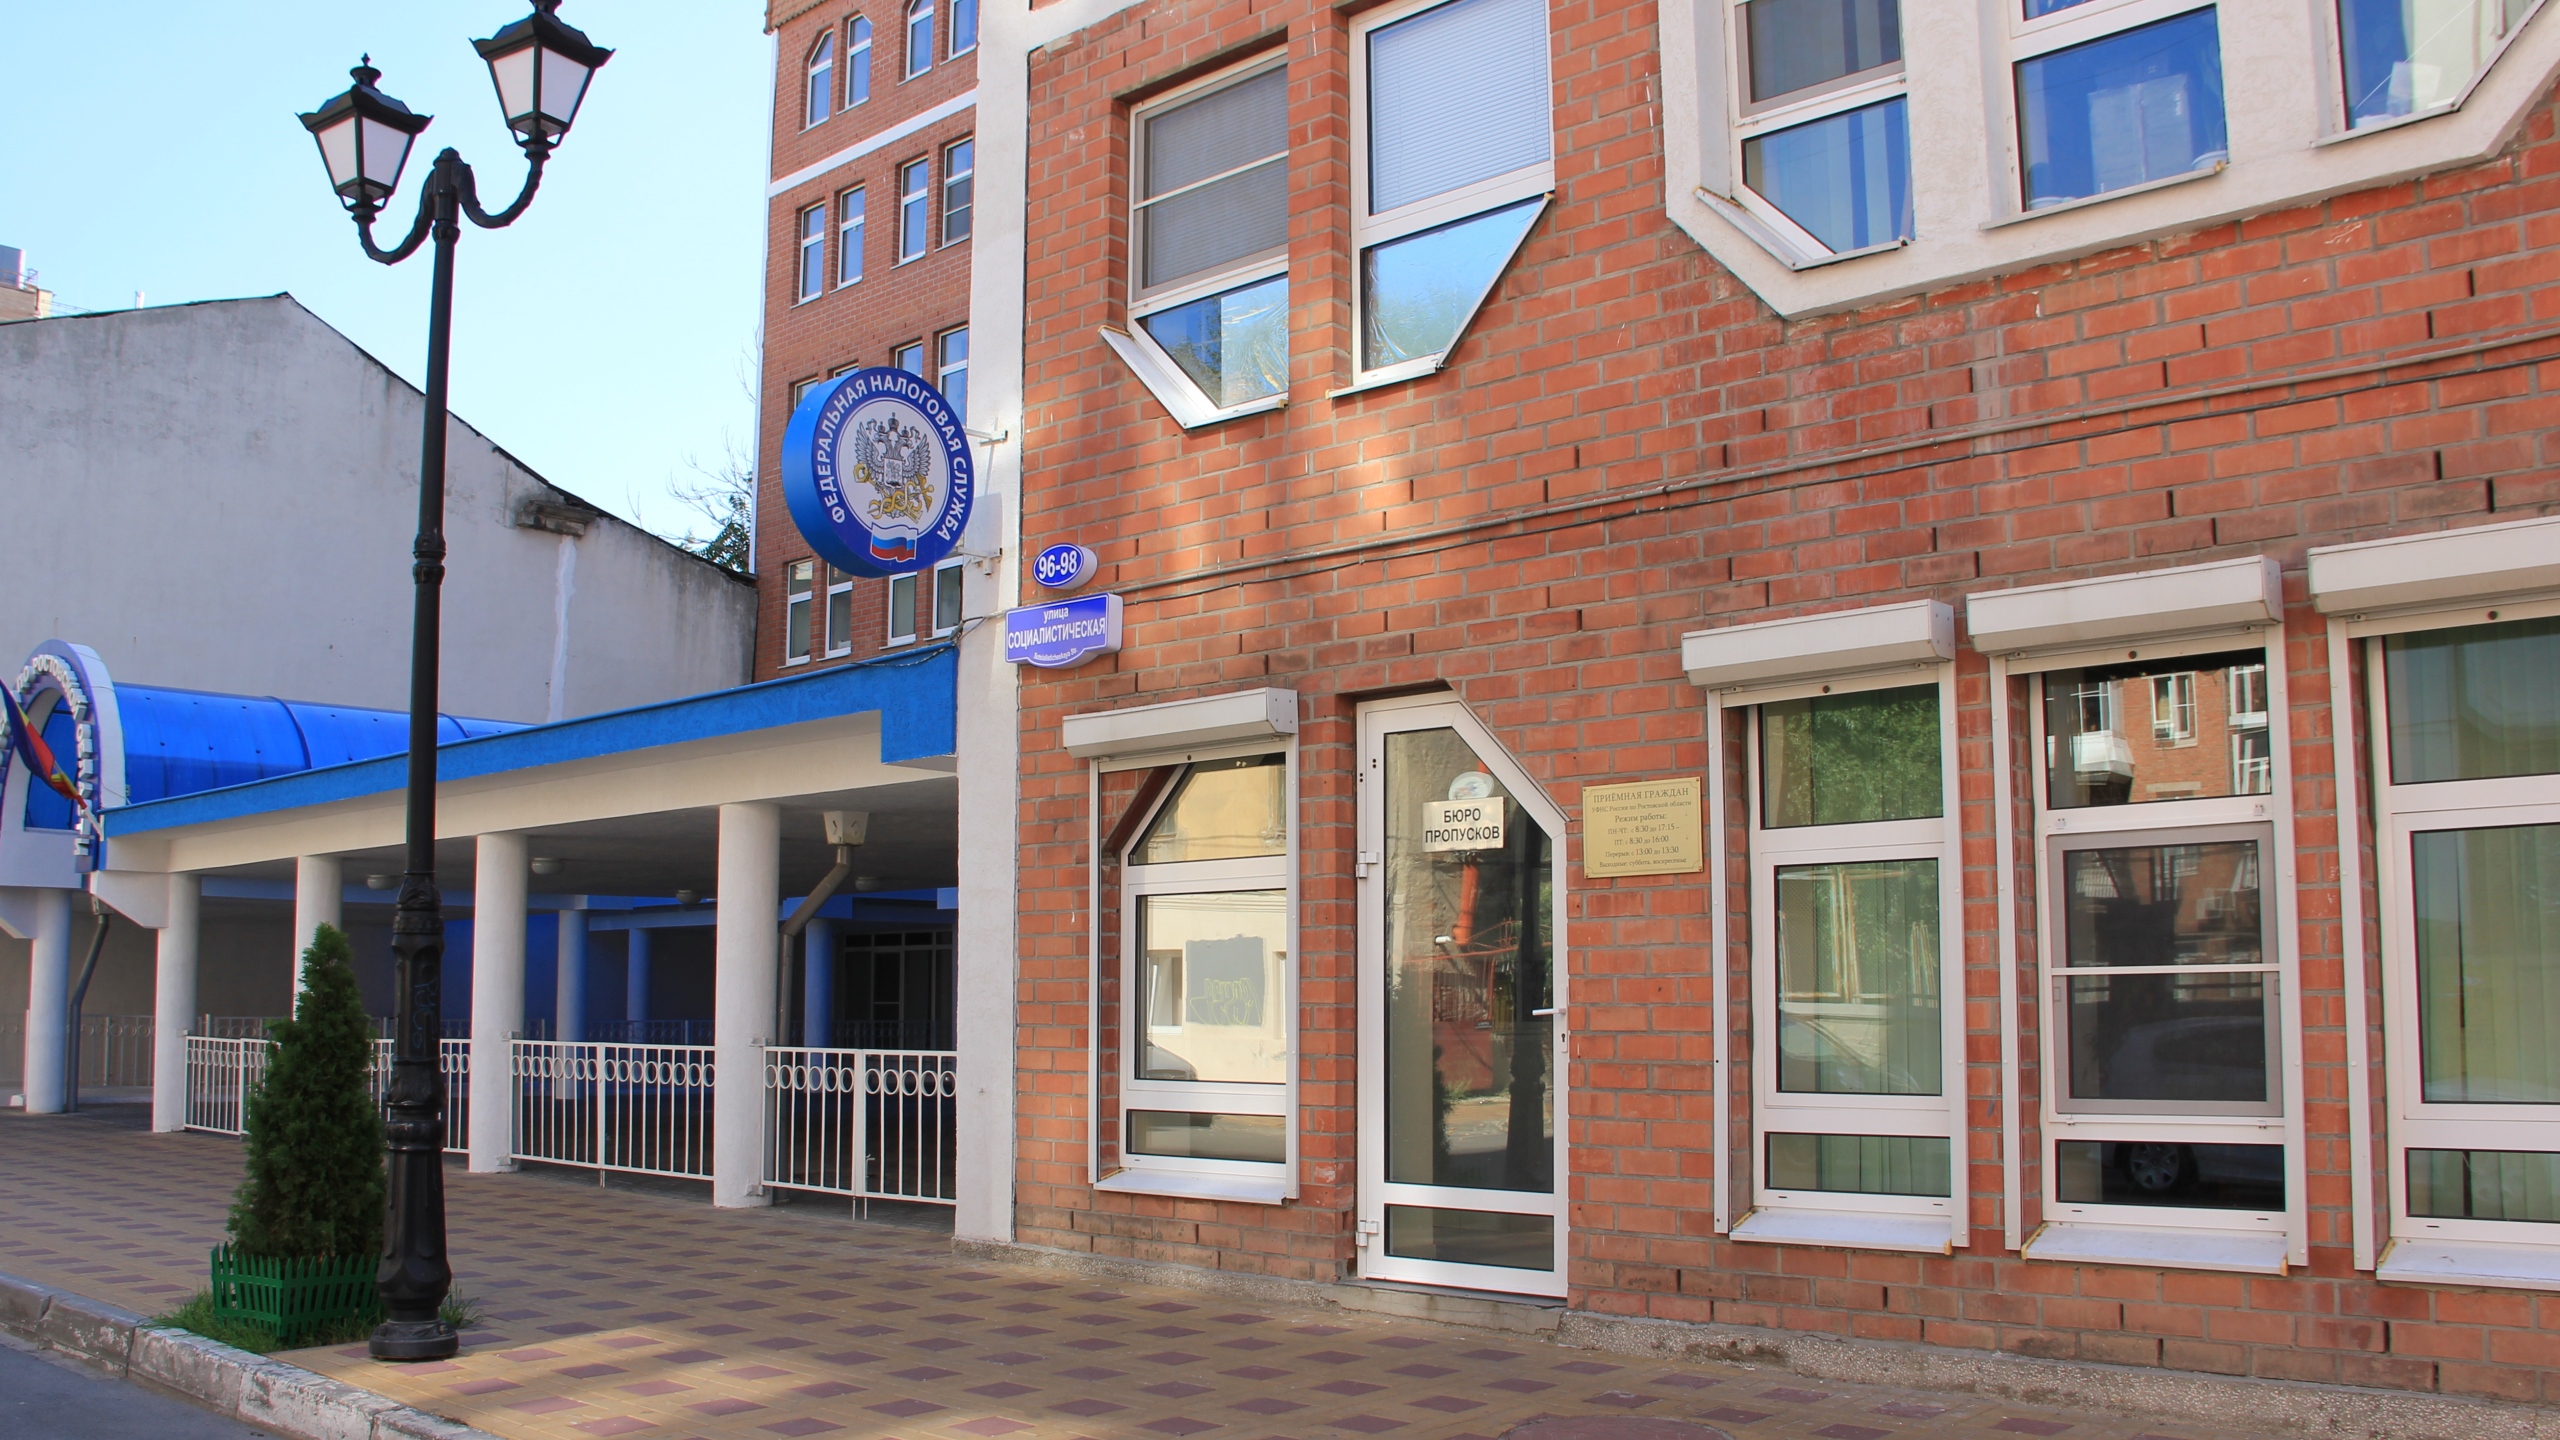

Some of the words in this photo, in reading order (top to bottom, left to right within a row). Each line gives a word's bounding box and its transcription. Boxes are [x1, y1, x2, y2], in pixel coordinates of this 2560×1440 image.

[817, 379, 868, 524] ФЕДЕРАЛЬНАЯ
[870, 375, 962, 453] НАЛОГОВАЯ
[936, 456, 968, 541] СЛУЖБА
[1038, 550, 1078, 580] 96-98
[1043, 607, 1069, 624] улица
[1008, 617, 1106, 650] СОЦИАЛИСТИЧЕСКАЯ
[1644, 788, 1689, 798] ГРАЖДАН
[1444, 808, 1481, 823] БЮРО
[1425, 826, 1500, 843] ПРОПУСКОВ
[1635, 825, 1648, 833] 8:30
[1658, 823, 1675, 831] 17:15
[1652, 835, 1669, 843] 16:00
[1662, 846, 1679, 854] 13:30
